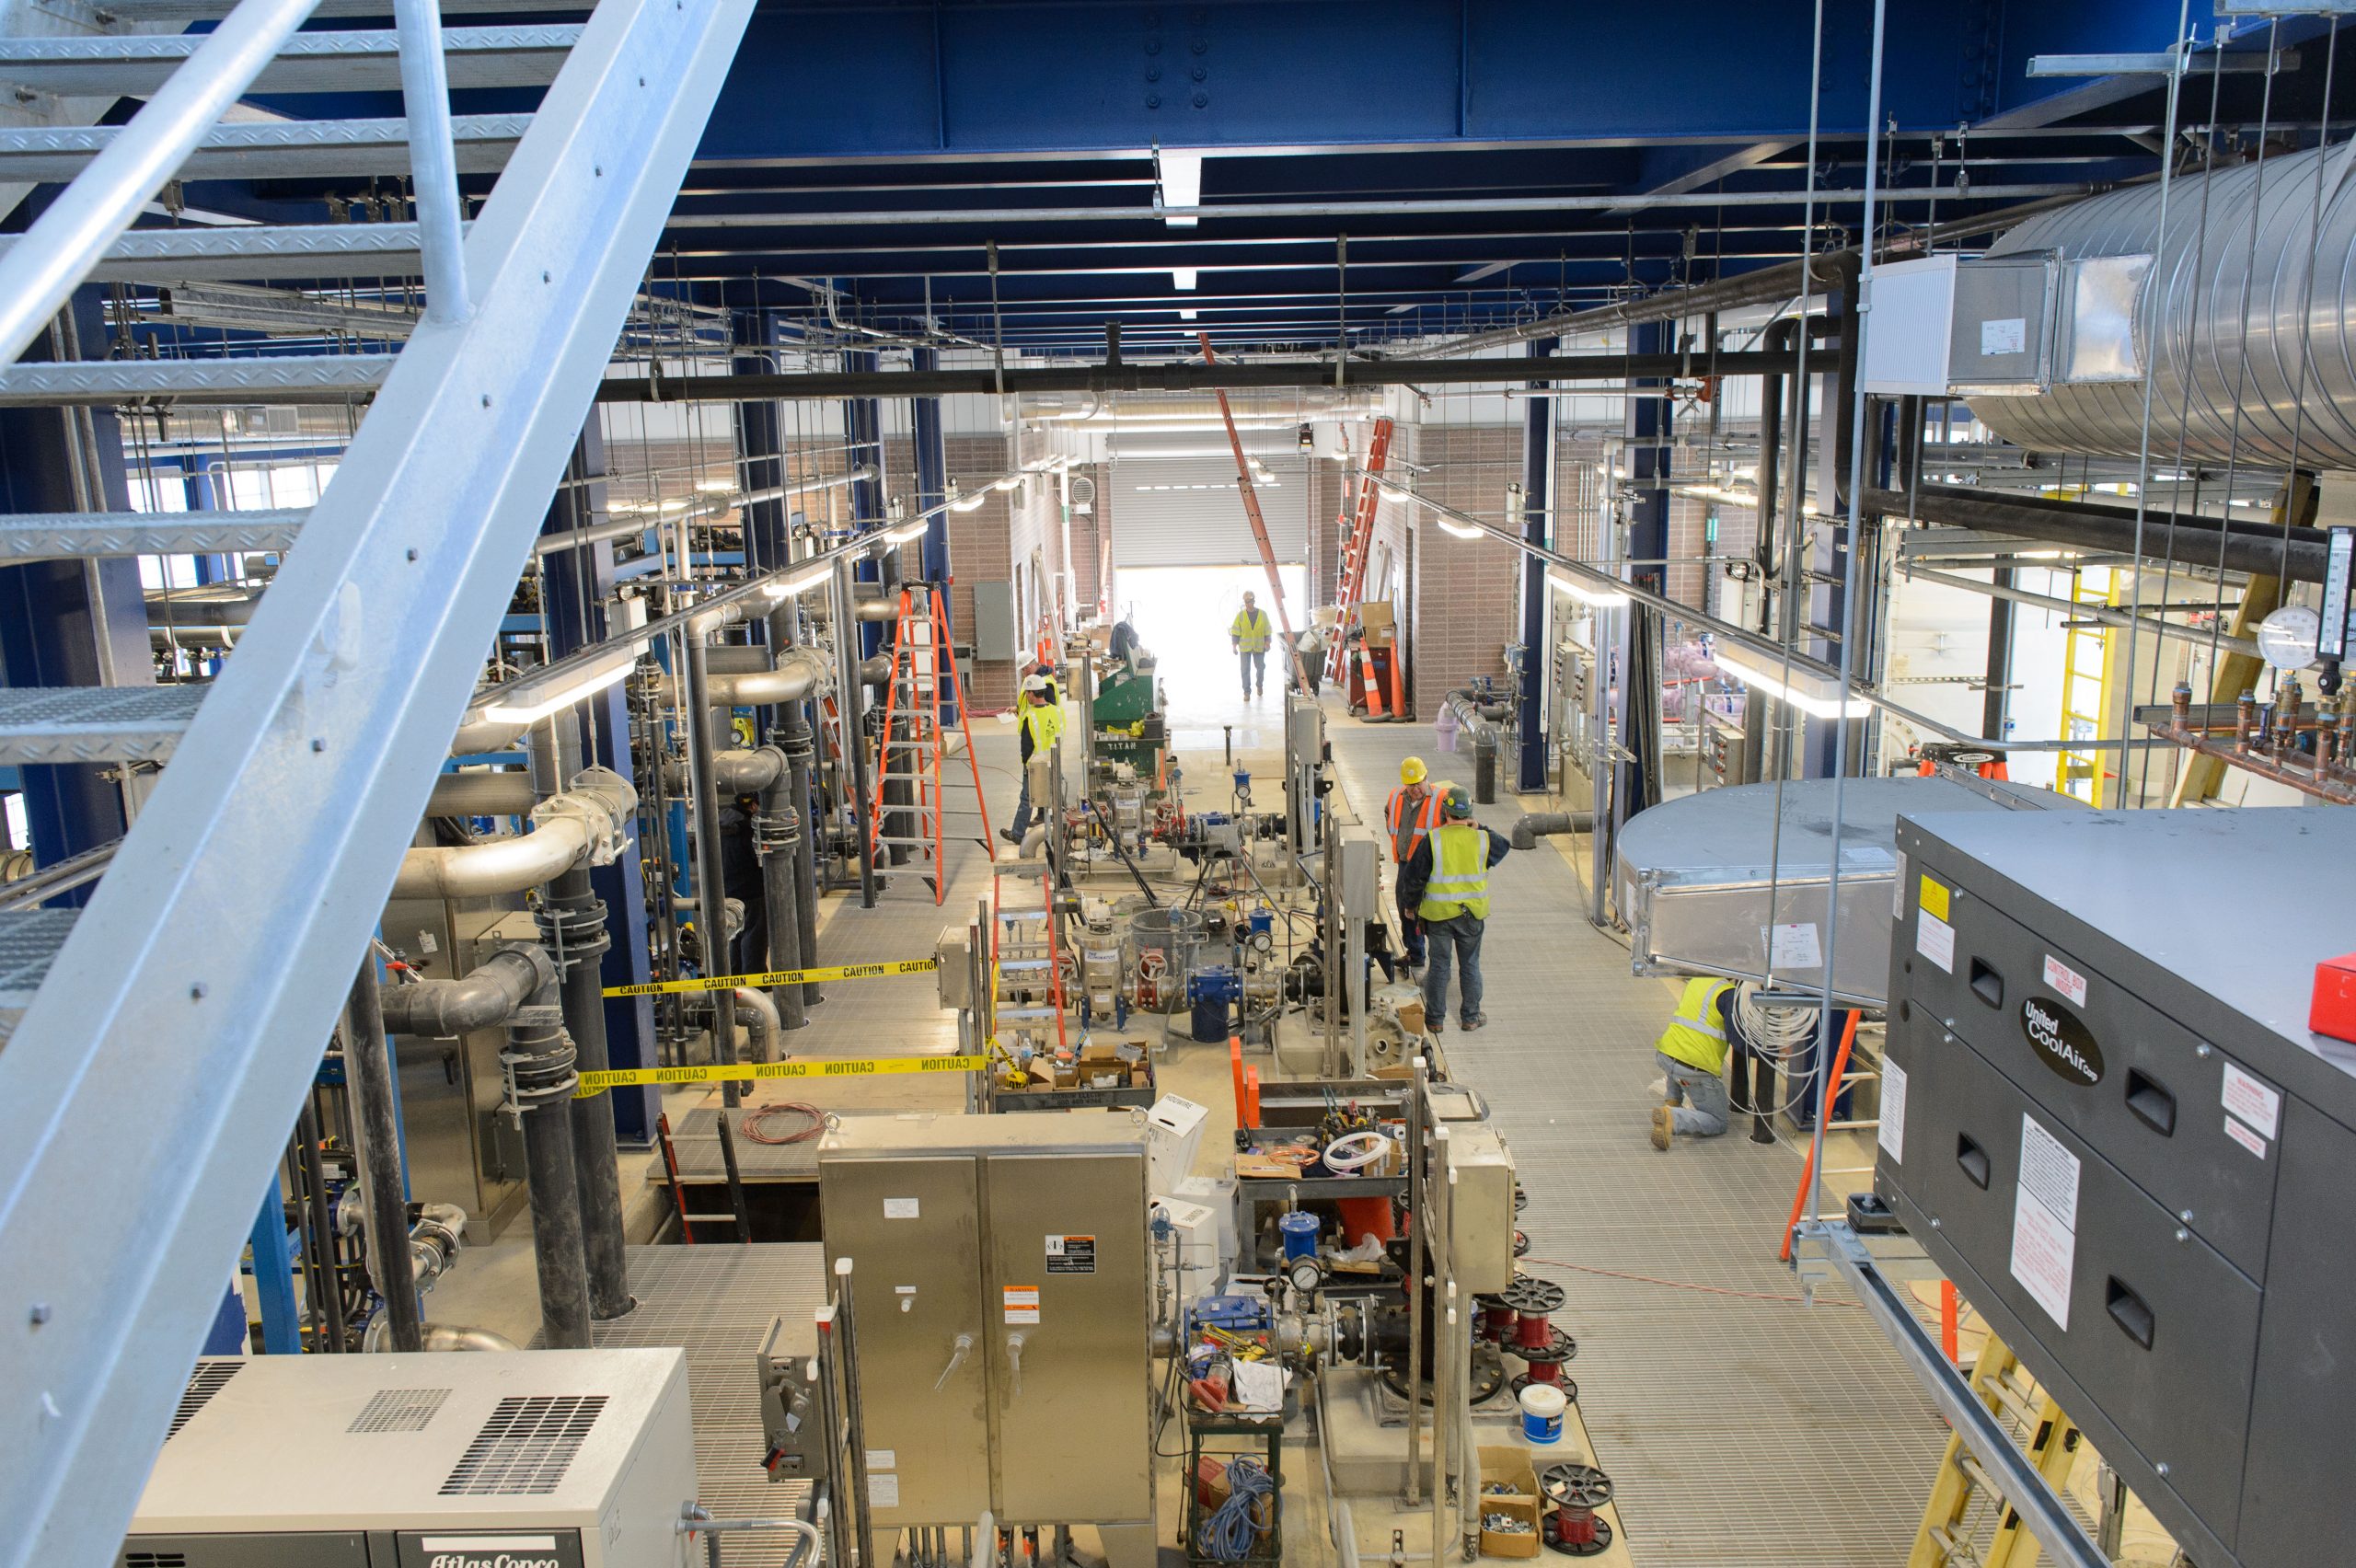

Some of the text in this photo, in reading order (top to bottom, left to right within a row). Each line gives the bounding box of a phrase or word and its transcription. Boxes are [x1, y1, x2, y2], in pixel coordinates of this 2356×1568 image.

[1107, 742, 1137, 751] TITAN
[619, 984, 664, 995] CAUTION
[704, 976, 746, 989] CAUTION
[762, 972, 804, 985] CAUTION
[843, 964, 884, 978] CAUTION
[2025, 999, 2059, 1035] United
[2027, 1019, 2086, 1071] CoolAir
[430, 1554, 492, 1568] Atlas
